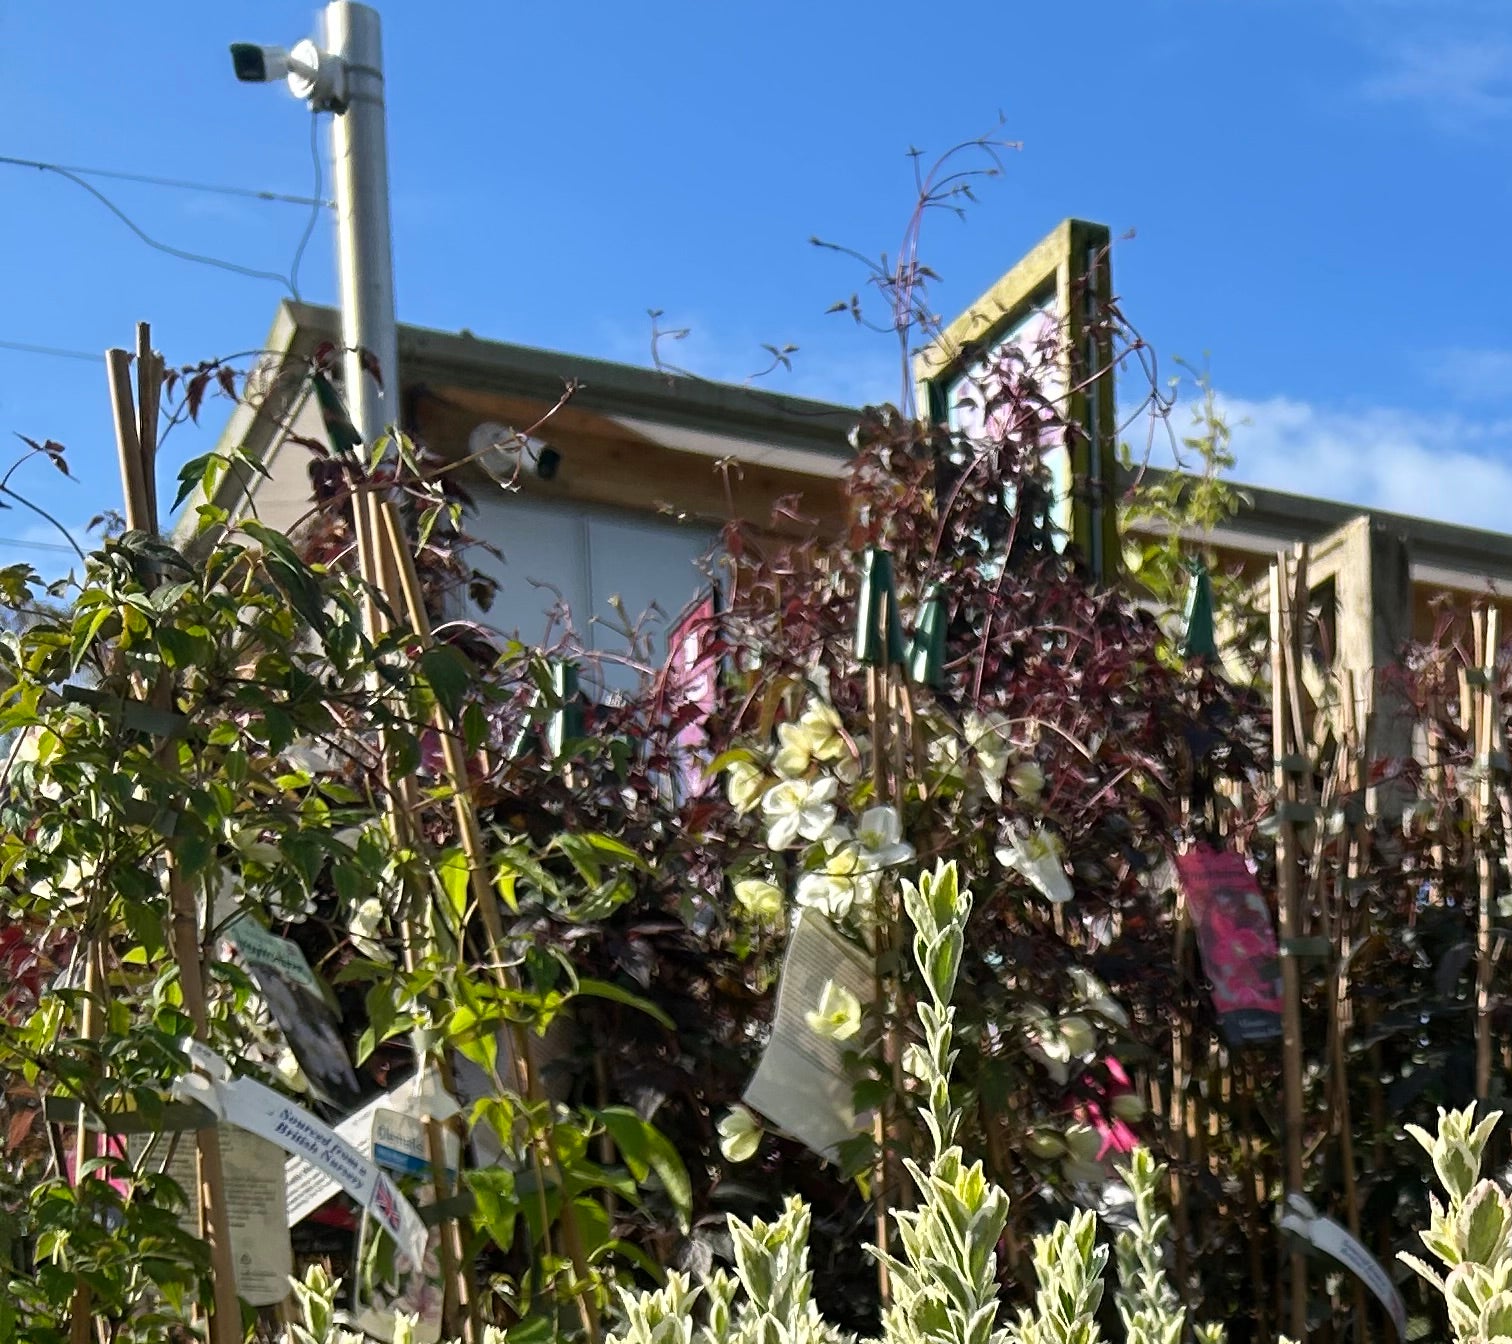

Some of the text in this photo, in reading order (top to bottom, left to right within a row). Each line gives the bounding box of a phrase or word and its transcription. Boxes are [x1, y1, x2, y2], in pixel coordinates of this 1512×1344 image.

[275, 1122, 318, 1153] British
[320, 1149, 364, 1189] Nursery
[279, 1108, 332, 1146] Sourced
[331, 1143, 362, 1170] from
